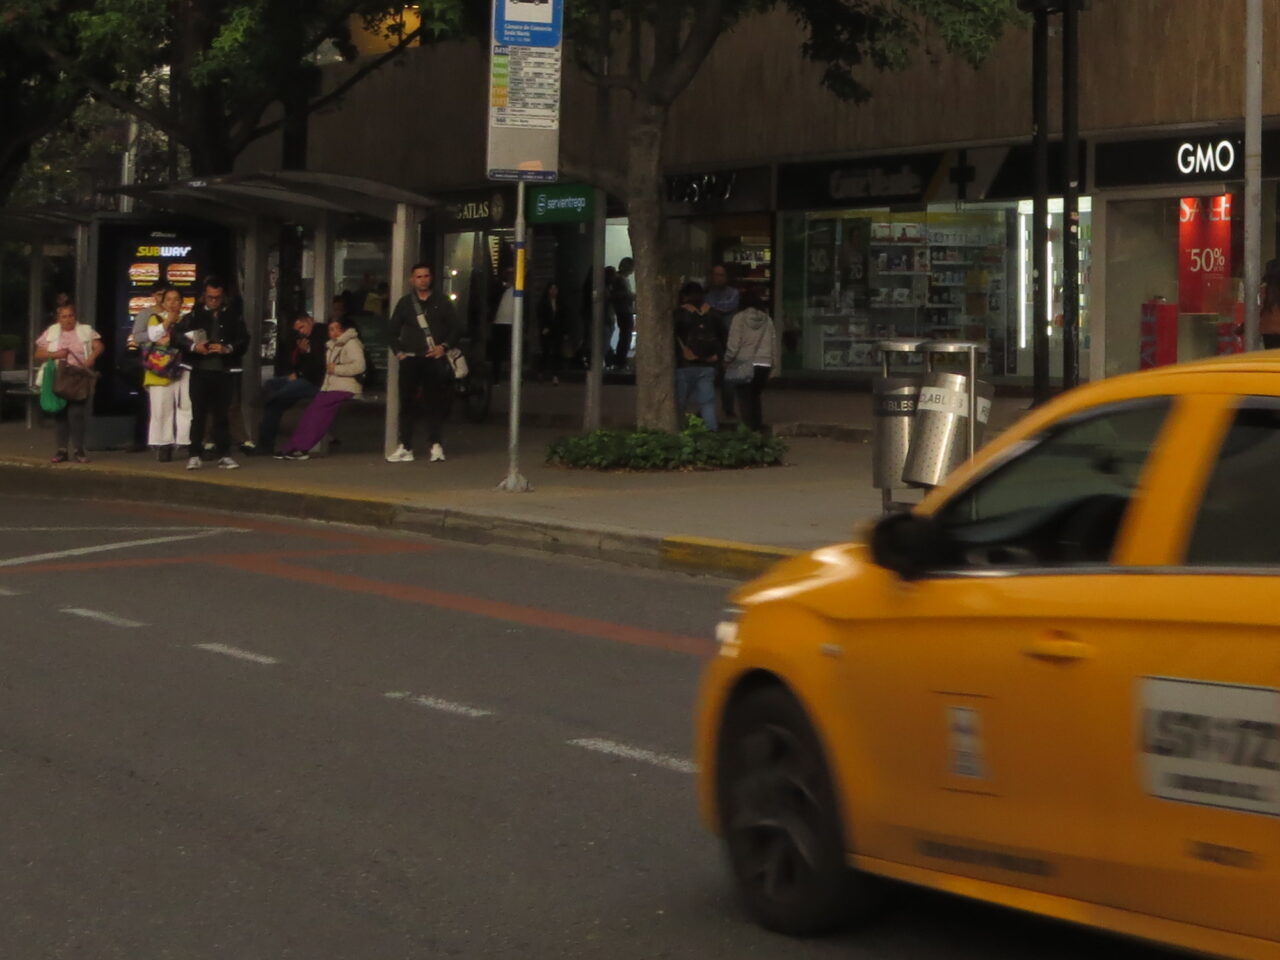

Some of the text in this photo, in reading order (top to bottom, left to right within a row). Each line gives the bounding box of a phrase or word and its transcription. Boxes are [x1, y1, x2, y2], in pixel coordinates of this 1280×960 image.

[1177, 140, 1235, 174] GMO
[462, 201, 489, 219] ATLAS
[136, 245, 192, 257] SUBWAY
[1190, 247, 1226, 274] 50%
